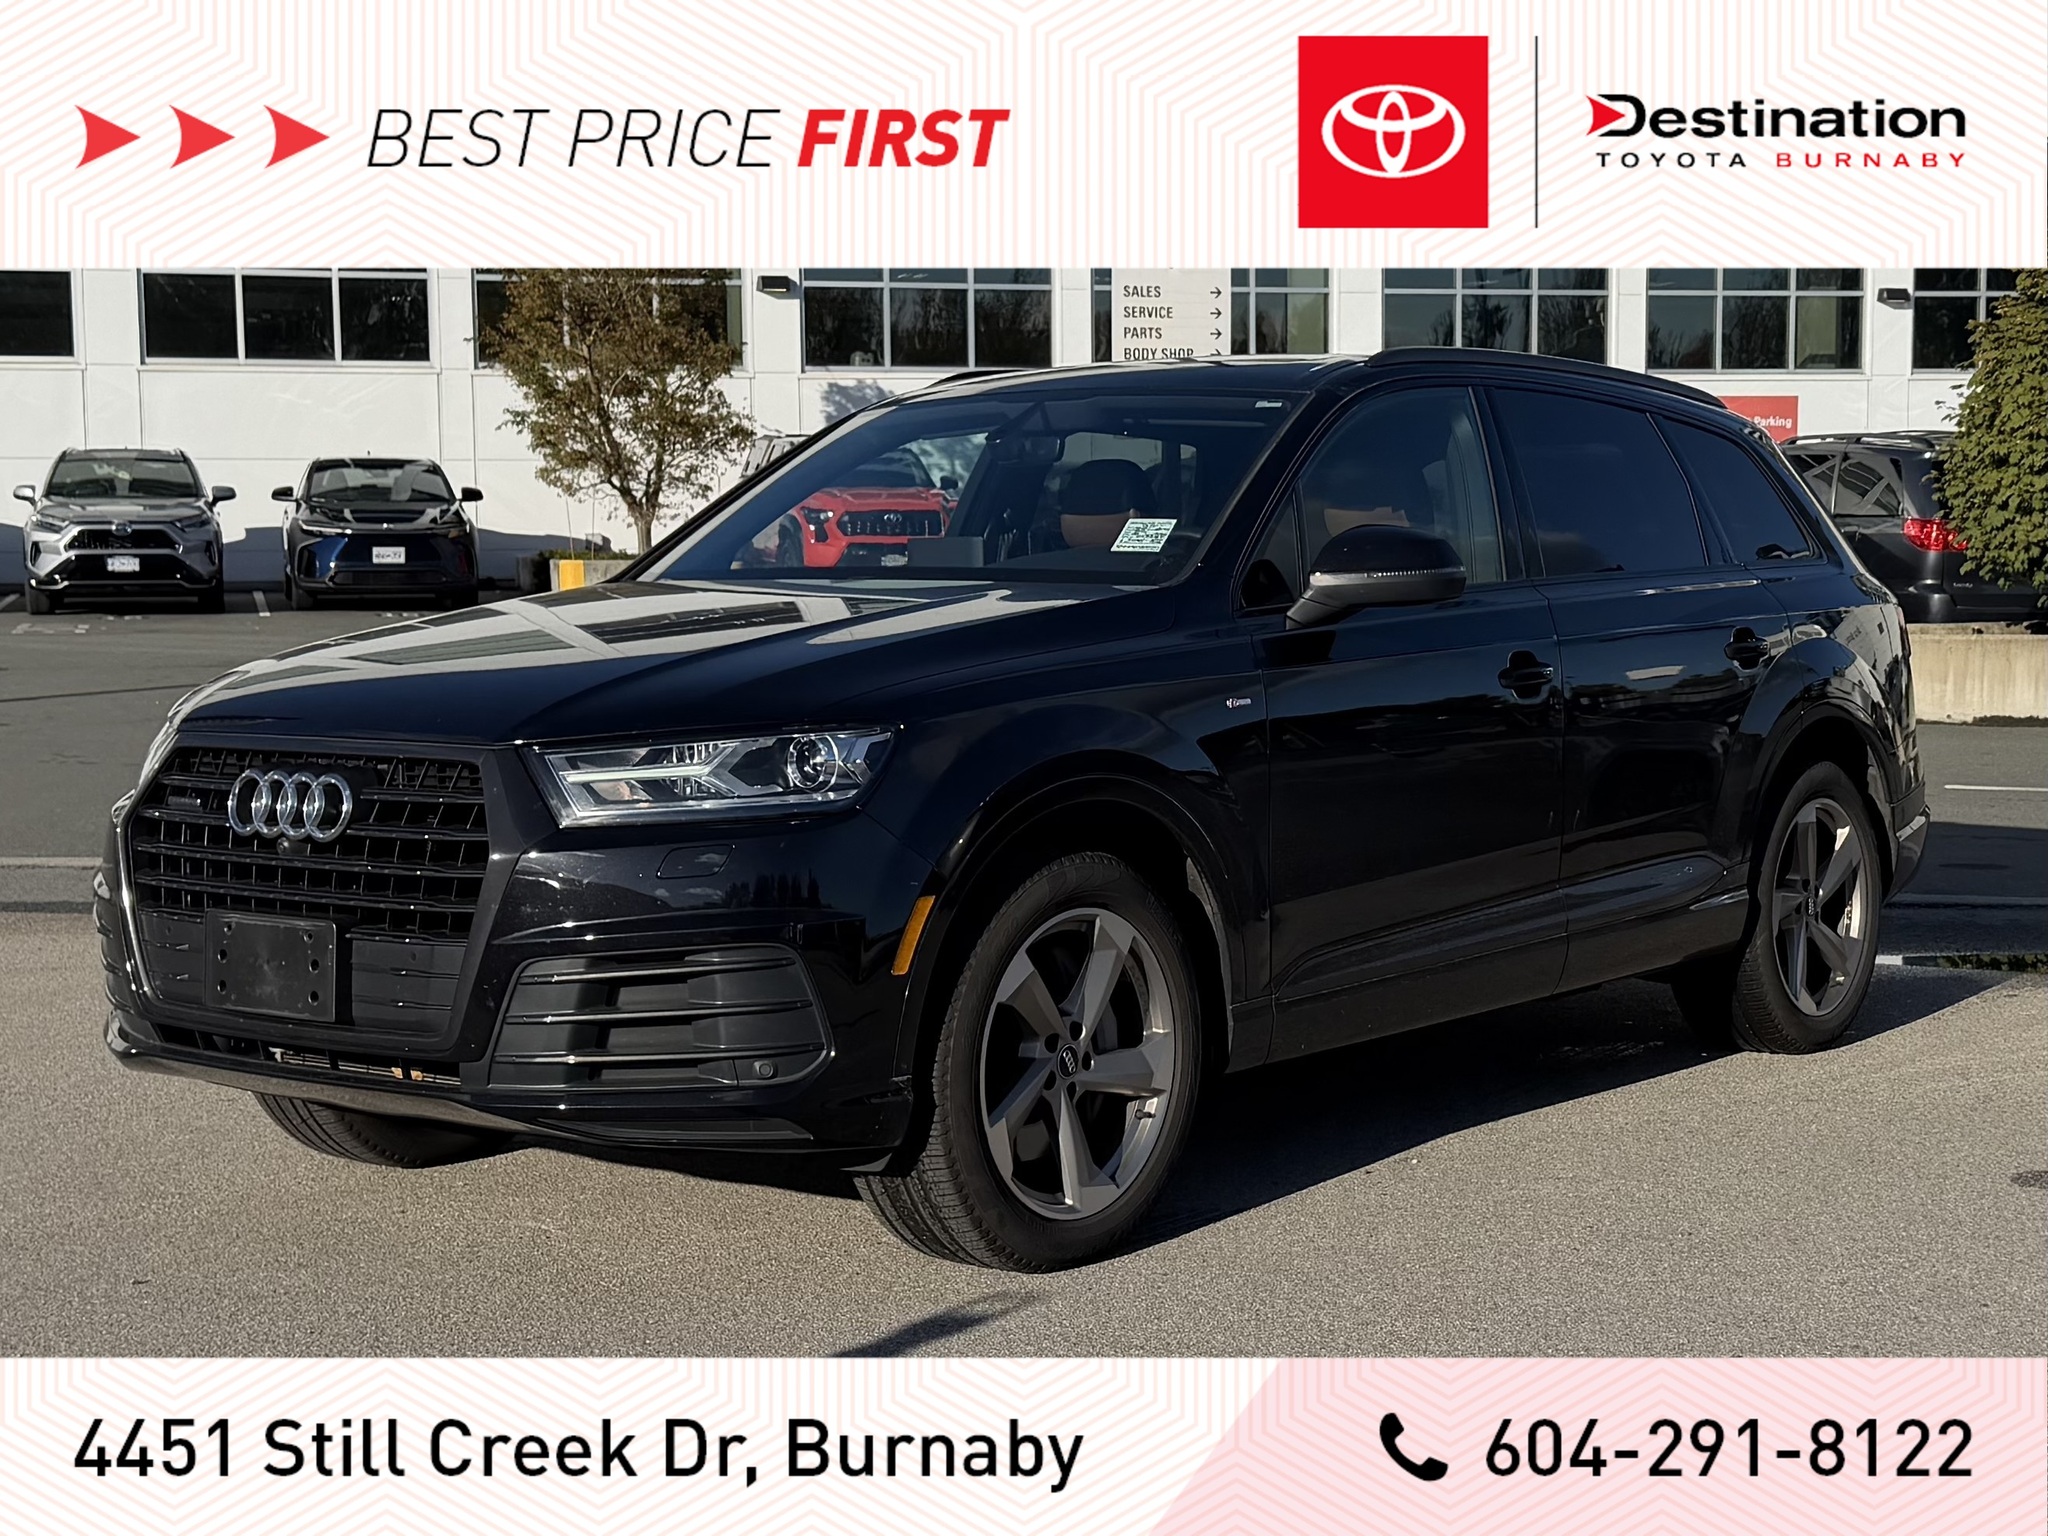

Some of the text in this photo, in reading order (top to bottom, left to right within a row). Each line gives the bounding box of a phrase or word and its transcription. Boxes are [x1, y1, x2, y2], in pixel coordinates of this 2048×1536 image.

[1123, 285, 1161, 298] SALES
[1123, 306, 1173, 319] SERVICE
[1123, 327, 1162, 339] PARTS
[1123, 347, 1157, 360] BODY
[1753, 416, 1792, 428] Parking
